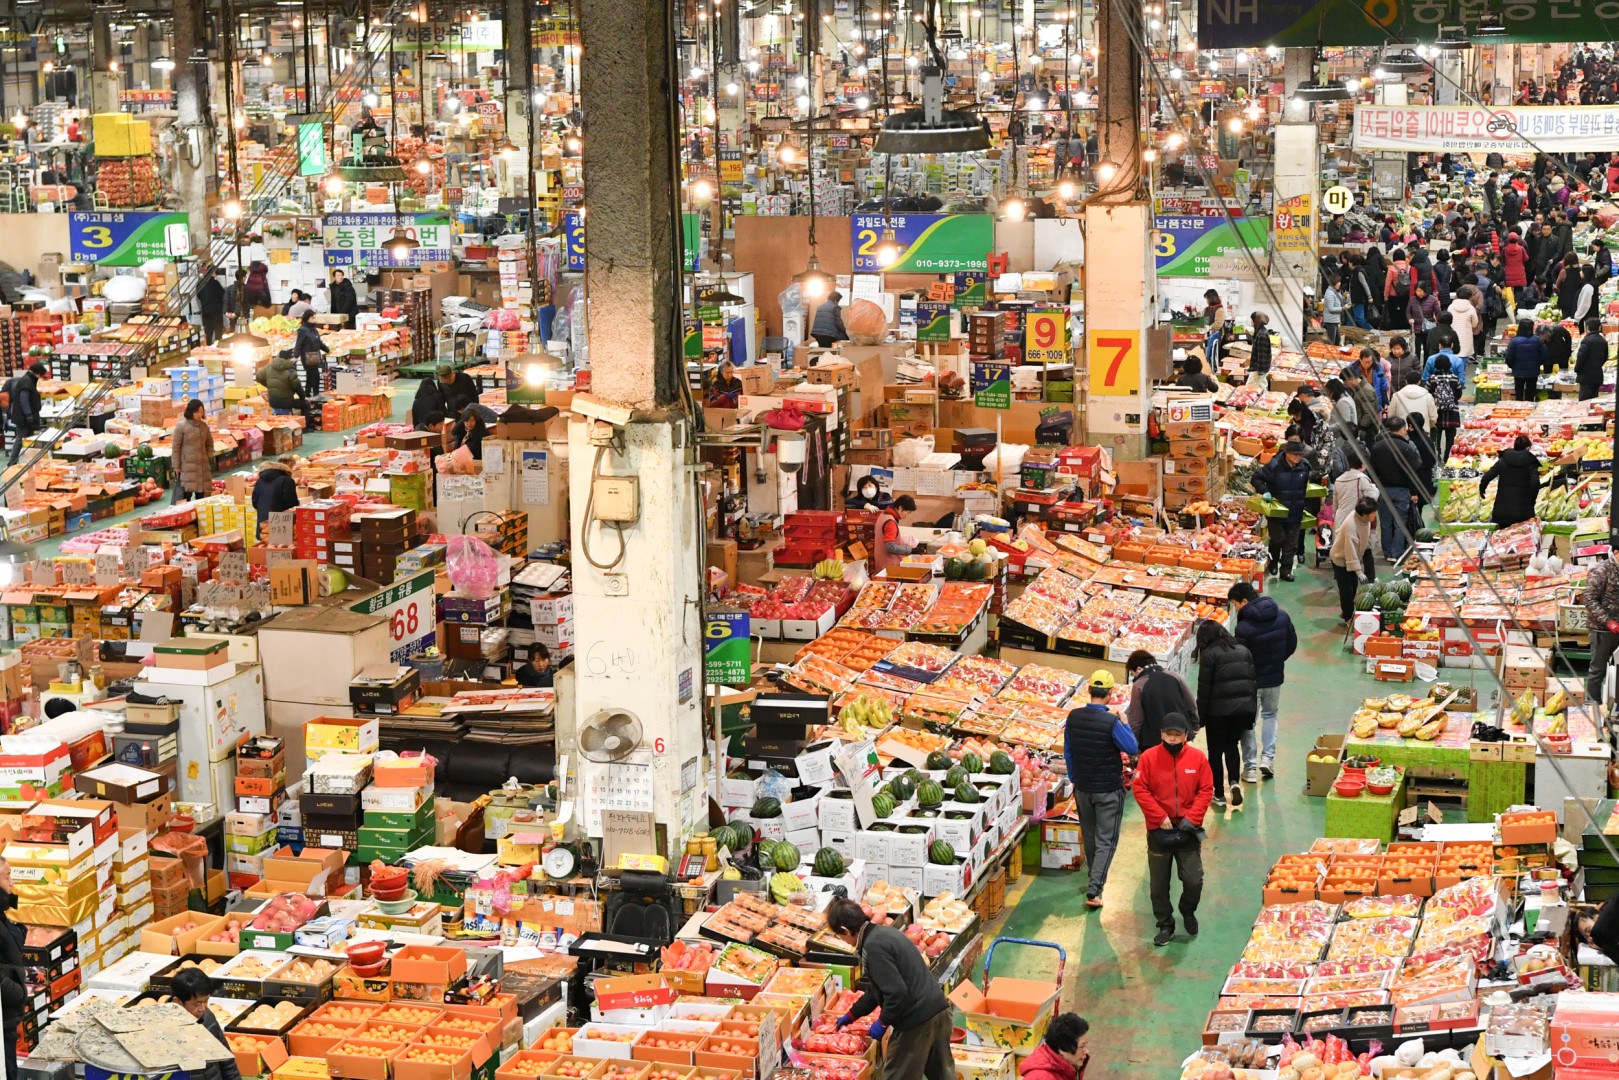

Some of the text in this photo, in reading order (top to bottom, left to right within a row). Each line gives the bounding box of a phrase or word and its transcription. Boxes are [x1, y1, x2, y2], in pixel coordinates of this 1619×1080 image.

[1206, 0, 1258, 25] NH
[1329, 192, 1348, 209] 마
[1156, 219, 1205, 229] 납품전문
[82, 226, 113, 248] 3
[336, 227, 376, 248] 농협
[916, 259, 988, 268] 010-9373-1996
[965, 277, 975, 286] 9
[928, 309, 938, 319] 7
[1034, 317, 1056, 349] 9
[1027, 350, 1063, 360] 666-1009
[1096, 338, 1132, 387] 7
[982, 368, 1003, 380] 17
[398, 581, 413, 599] 유통
[393, 602, 419, 642] 68
[654, 737, 666, 754] 6
